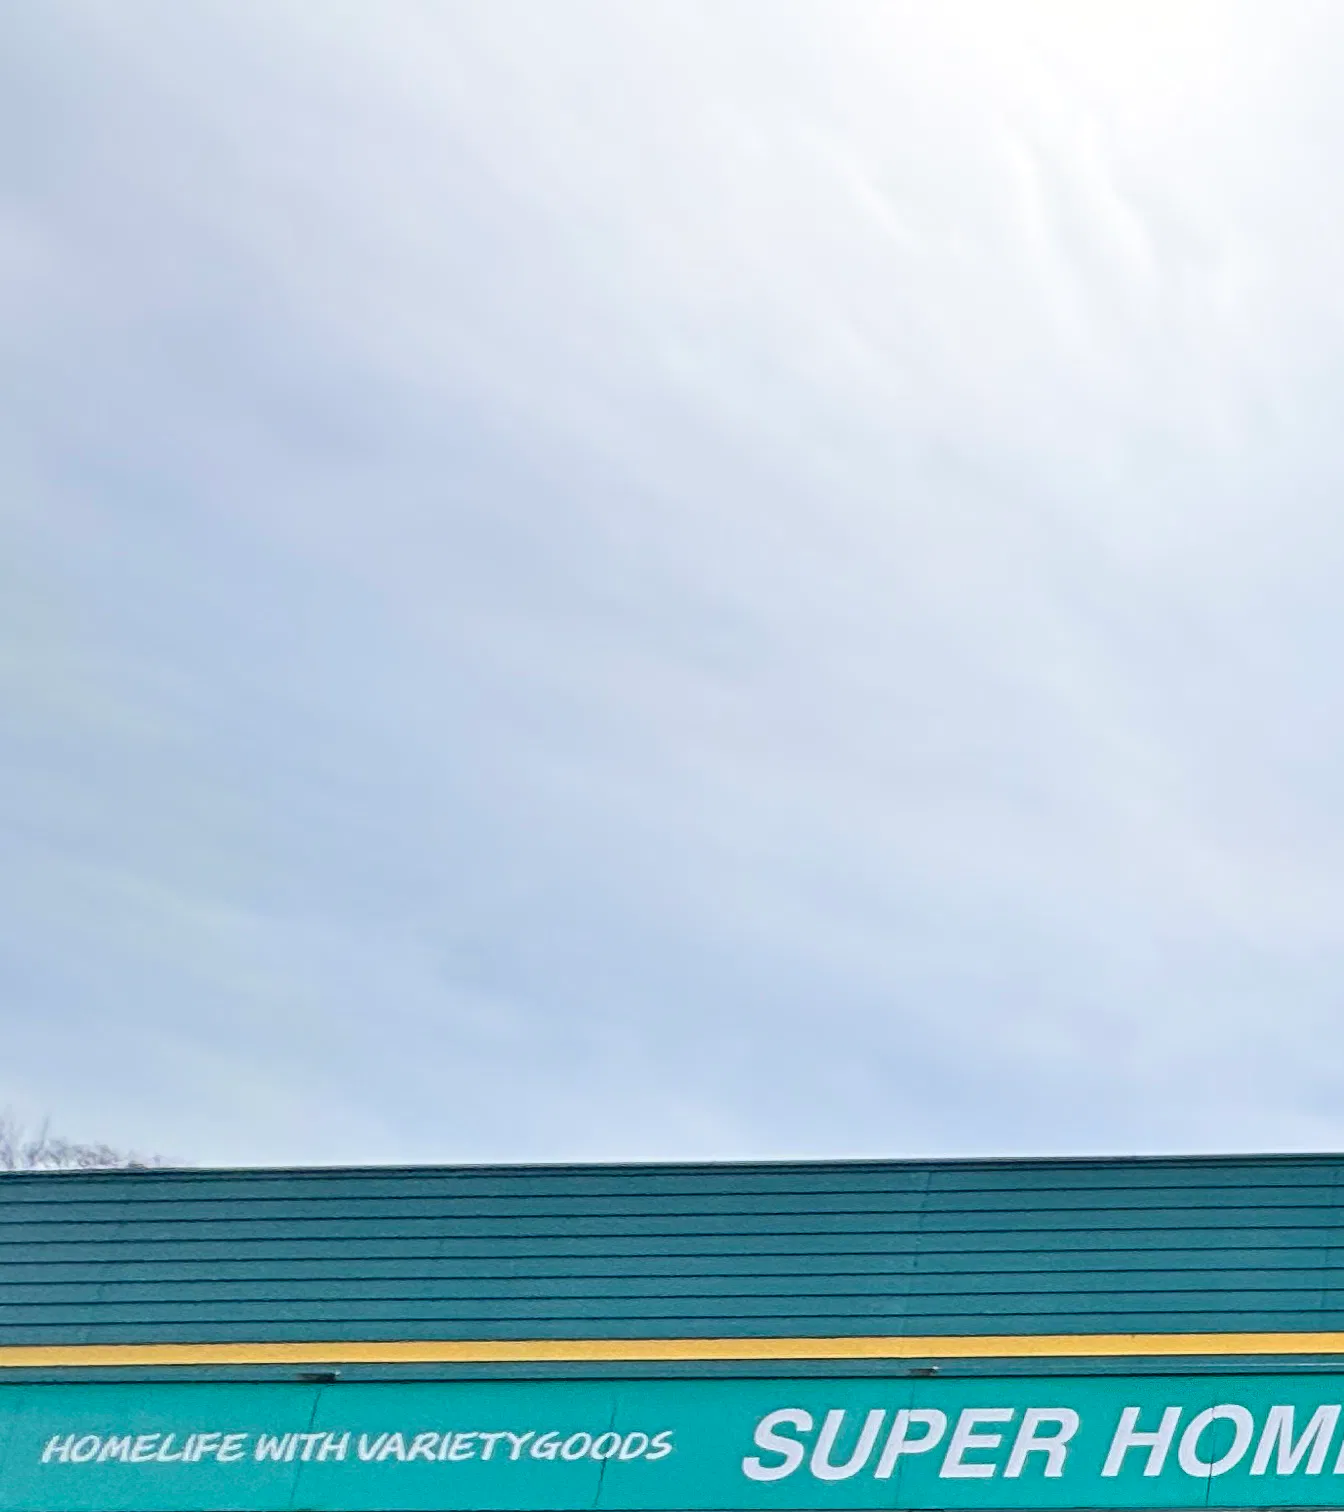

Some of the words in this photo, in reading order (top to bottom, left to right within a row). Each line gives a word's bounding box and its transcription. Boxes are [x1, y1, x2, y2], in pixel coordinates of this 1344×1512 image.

[42, 1433, 243, 1463] HOMELIFE
[255, 1432, 347, 1462] WITH
[743, 1408, 1080, 1481] SUPER
